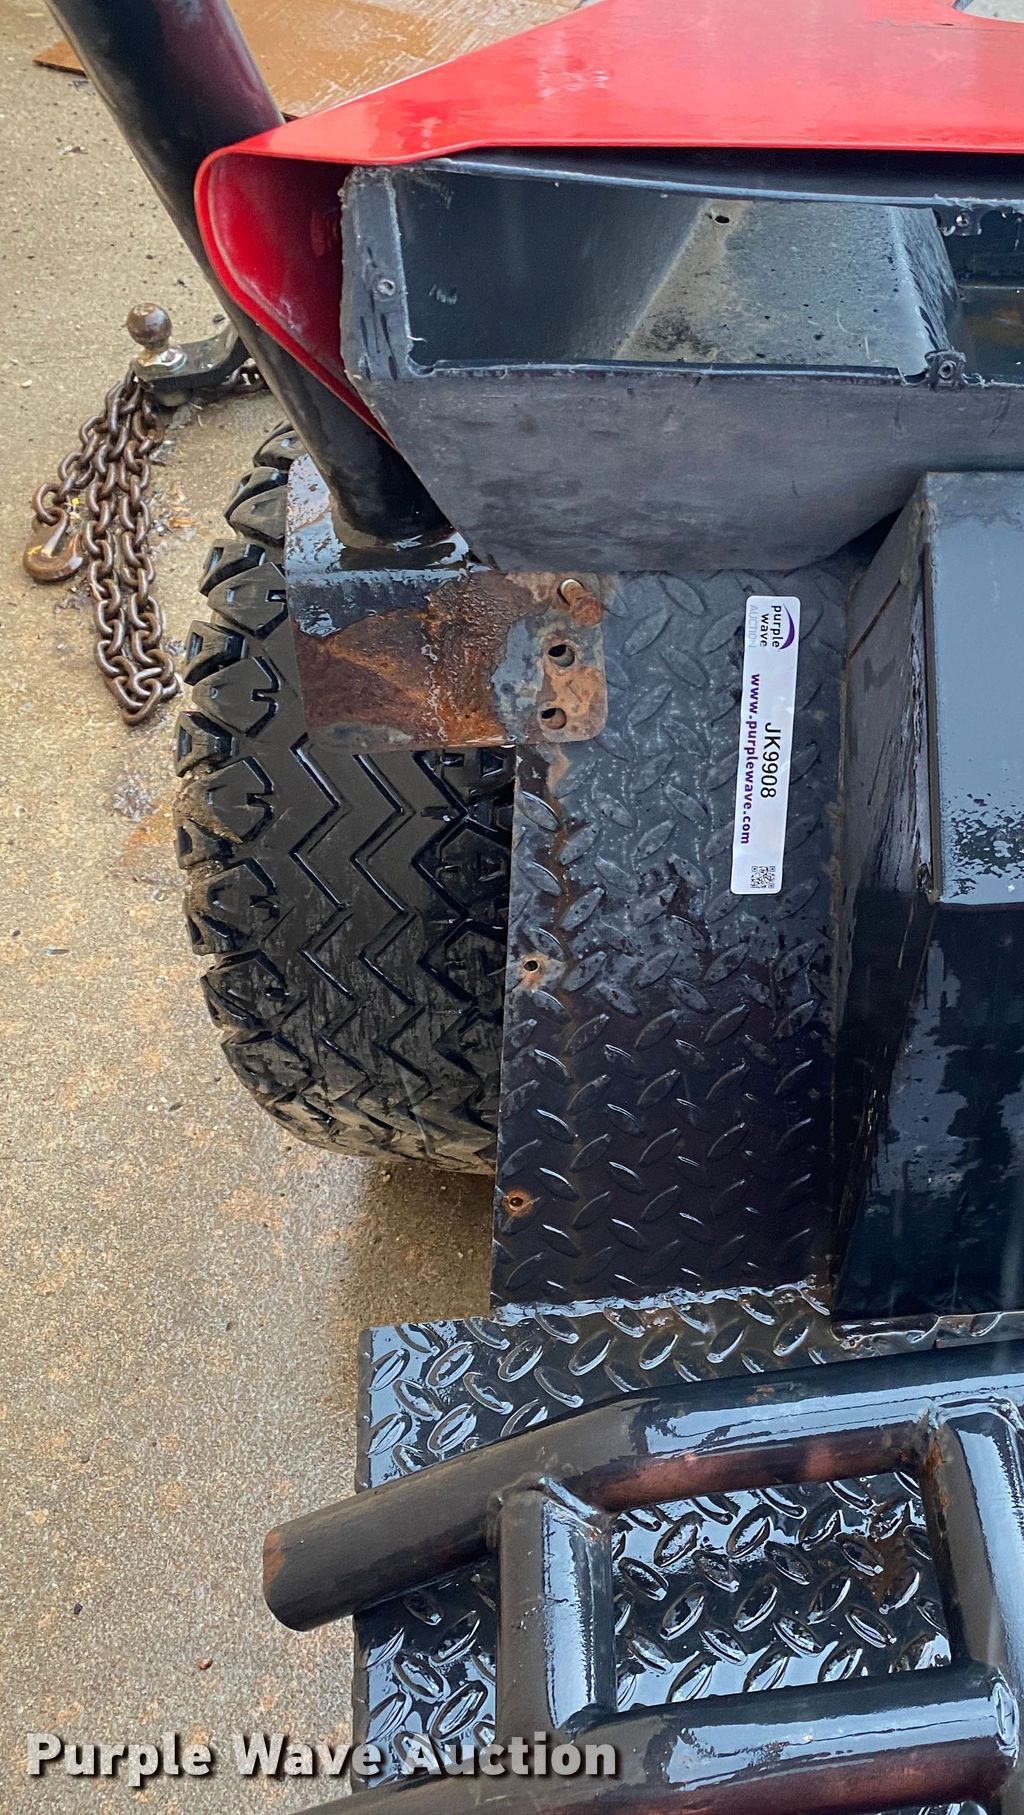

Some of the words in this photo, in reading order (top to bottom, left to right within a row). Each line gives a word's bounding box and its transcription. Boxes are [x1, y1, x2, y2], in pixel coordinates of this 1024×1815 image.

[748, 604, 759, 648] AUCTION
[760, 613, 769, 647] wave
[770, 605, 783, 648] purple
[741, 673, 760, 845] www.purplewave.com
[760, 722, 781, 799] JK9908
